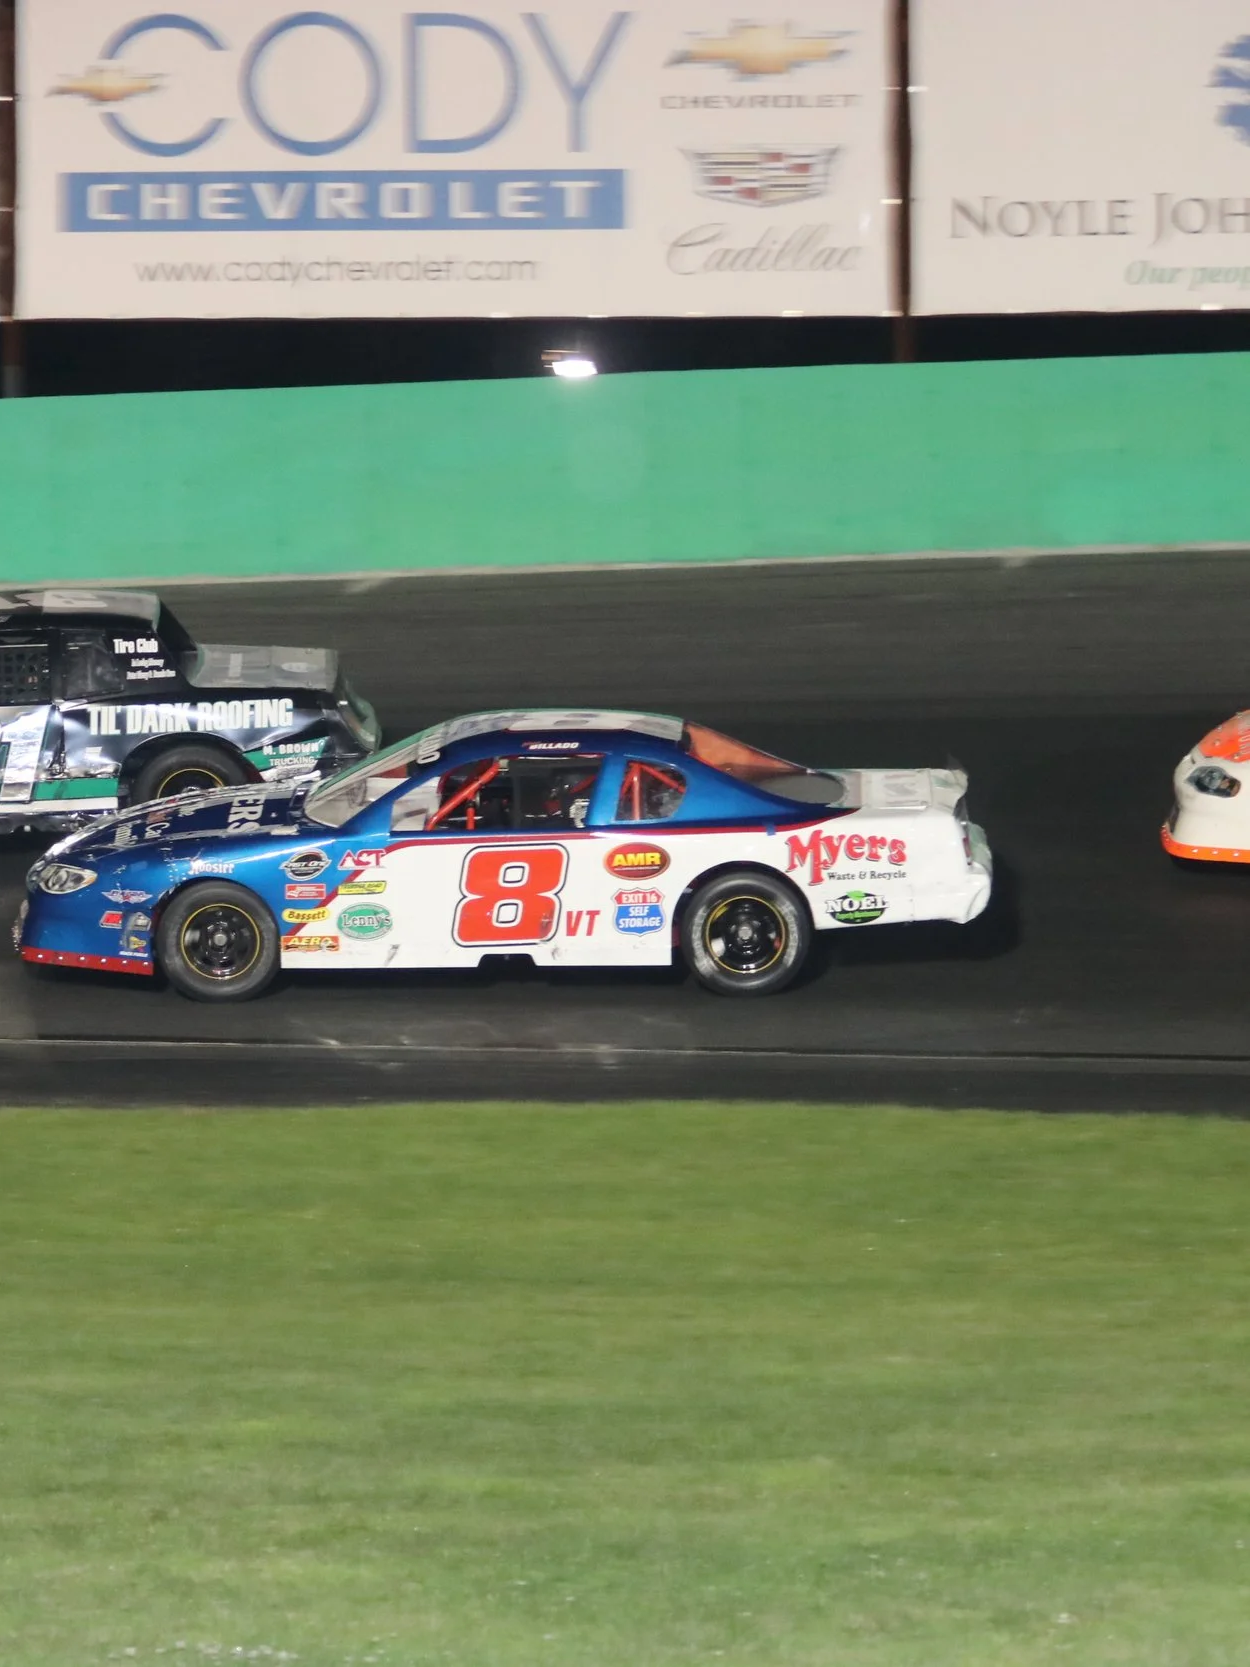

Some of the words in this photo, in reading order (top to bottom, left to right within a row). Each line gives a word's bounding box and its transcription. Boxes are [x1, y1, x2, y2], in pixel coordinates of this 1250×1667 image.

[99, 11, 635, 157] CODY
[660, 93, 860, 109] CHEVROLET
[86, 181, 604, 220] CHEVROLET
[948, 196, 1136, 238] NOYLE
[666, 222, 862, 275] Cadillac
[134, 256, 539, 286] www.codychevrolet.com
[126, 702, 191, 734] DARK
[197, 698, 293, 731] ROOFING
[279, 742, 319, 754] BROWN
[269, 756, 315, 766] TRUCKING
[611, 852, 661, 867] AMR
[785, 829, 906, 886] Myers
[827, 871, 856, 880] Waste
[870, 870, 906, 881] Recycle
[453, 844, 569, 947] 8
[621, 893, 644, 904] EXIT
[645, 892, 657, 903] 16
[826, 895, 890, 913] NOEL
[288, 909, 326, 920] Bassett
[628, 906, 650, 917] SELF
[342, 914, 391, 928] Lenny's
[565, 910, 601, 936] VT
[618, 916, 661, 929] STORAGE
